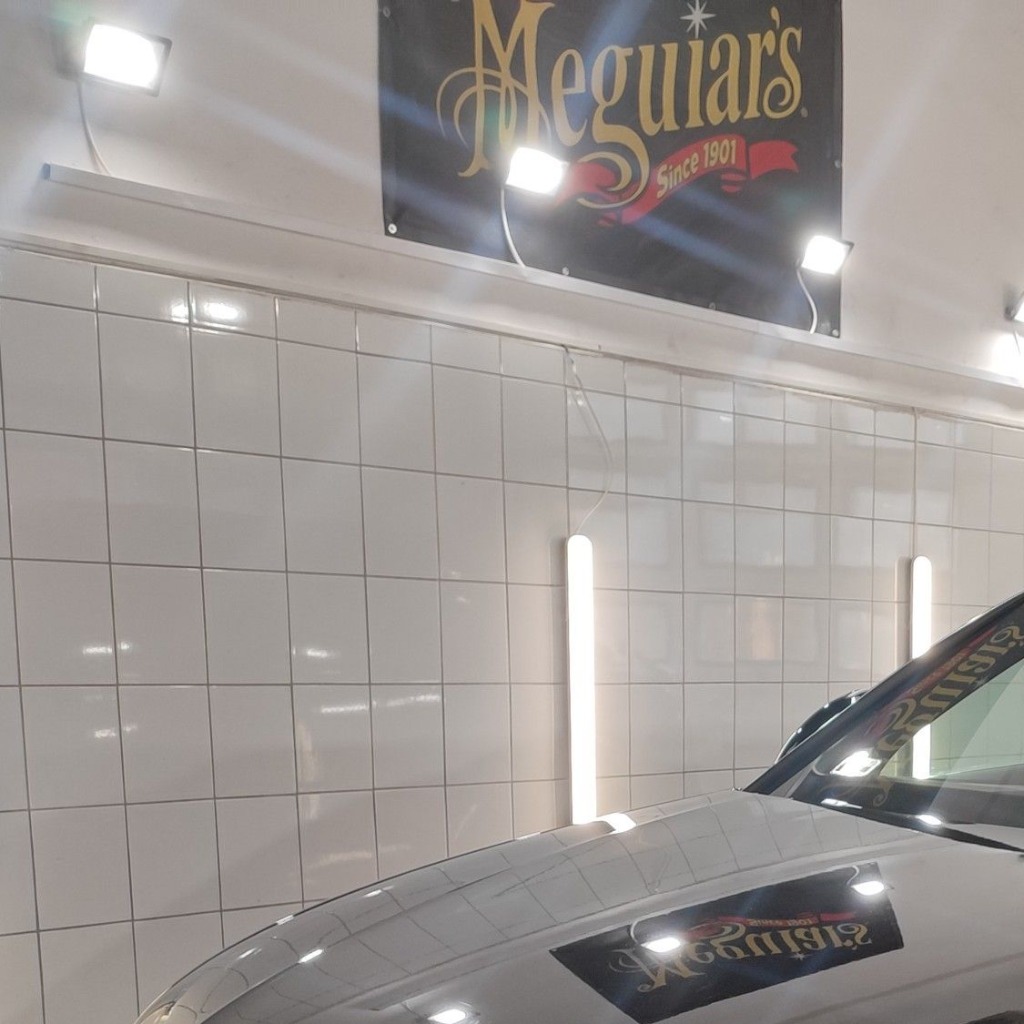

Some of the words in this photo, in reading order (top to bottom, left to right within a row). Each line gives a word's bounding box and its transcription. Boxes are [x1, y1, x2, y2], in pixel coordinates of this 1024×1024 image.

[437, 0, 803, 208] Meguiar's
[656, 152, 700, 199] Since
[703, 138, 737, 168] 1901
